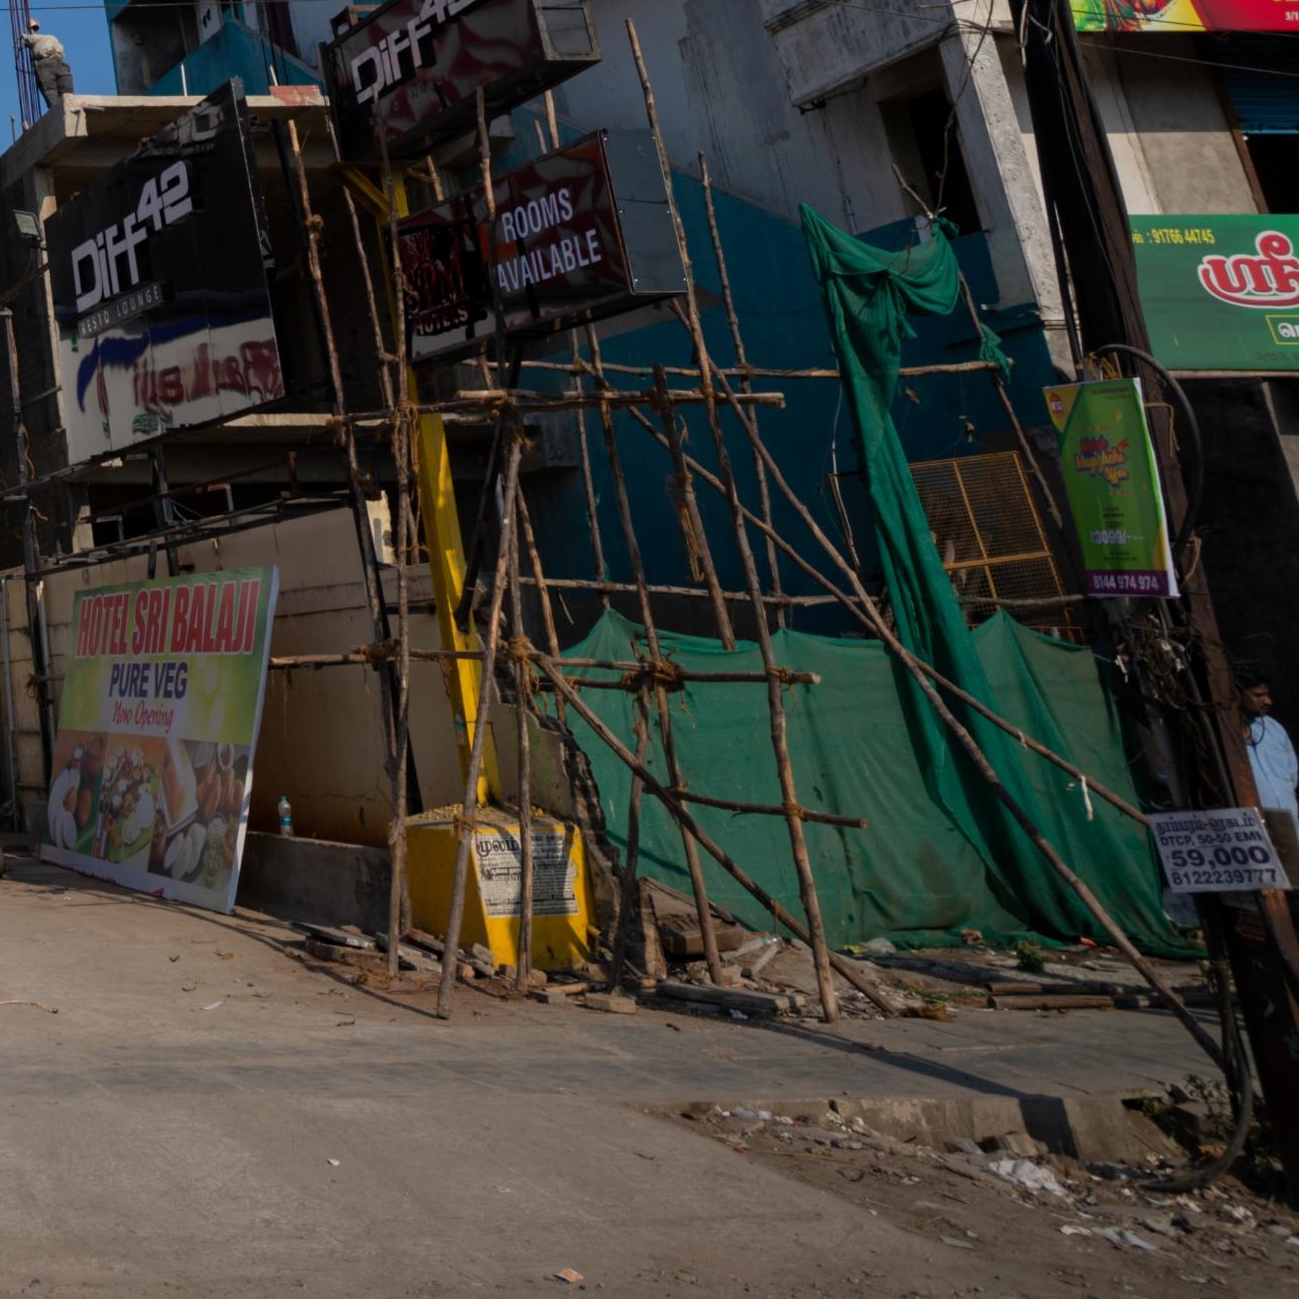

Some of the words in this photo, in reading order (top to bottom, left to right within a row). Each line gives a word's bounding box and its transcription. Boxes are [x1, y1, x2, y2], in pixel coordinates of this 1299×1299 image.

[501, 188, 573, 243] ROOMS
[497, 228, 602, 293] AVAILABLE
[81, 310, 110, 336] RESTO
[116, 285, 160, 321] LOUNGE
[1092, 573, 1116, 589] 8144
[1117, 574, 1138, 589] 974
[1138, 575, 1159, 590] 974
[75, 590, 131, 659] HOTEL
[131, 585, 172, 656] SRI
[169, 578, 260, 655] BALAJI
[109, 663, 152, 698] PURE
[154, 661, 188, 699] VEG
[112, 700, 131, 725] Now
[134, 699, 174, 733] Opening
[1197, 832, 1232, 844] 50-50
[1234, 830, 1262, 842] EMI
[1170, 846, 1270, 870] 59,000
